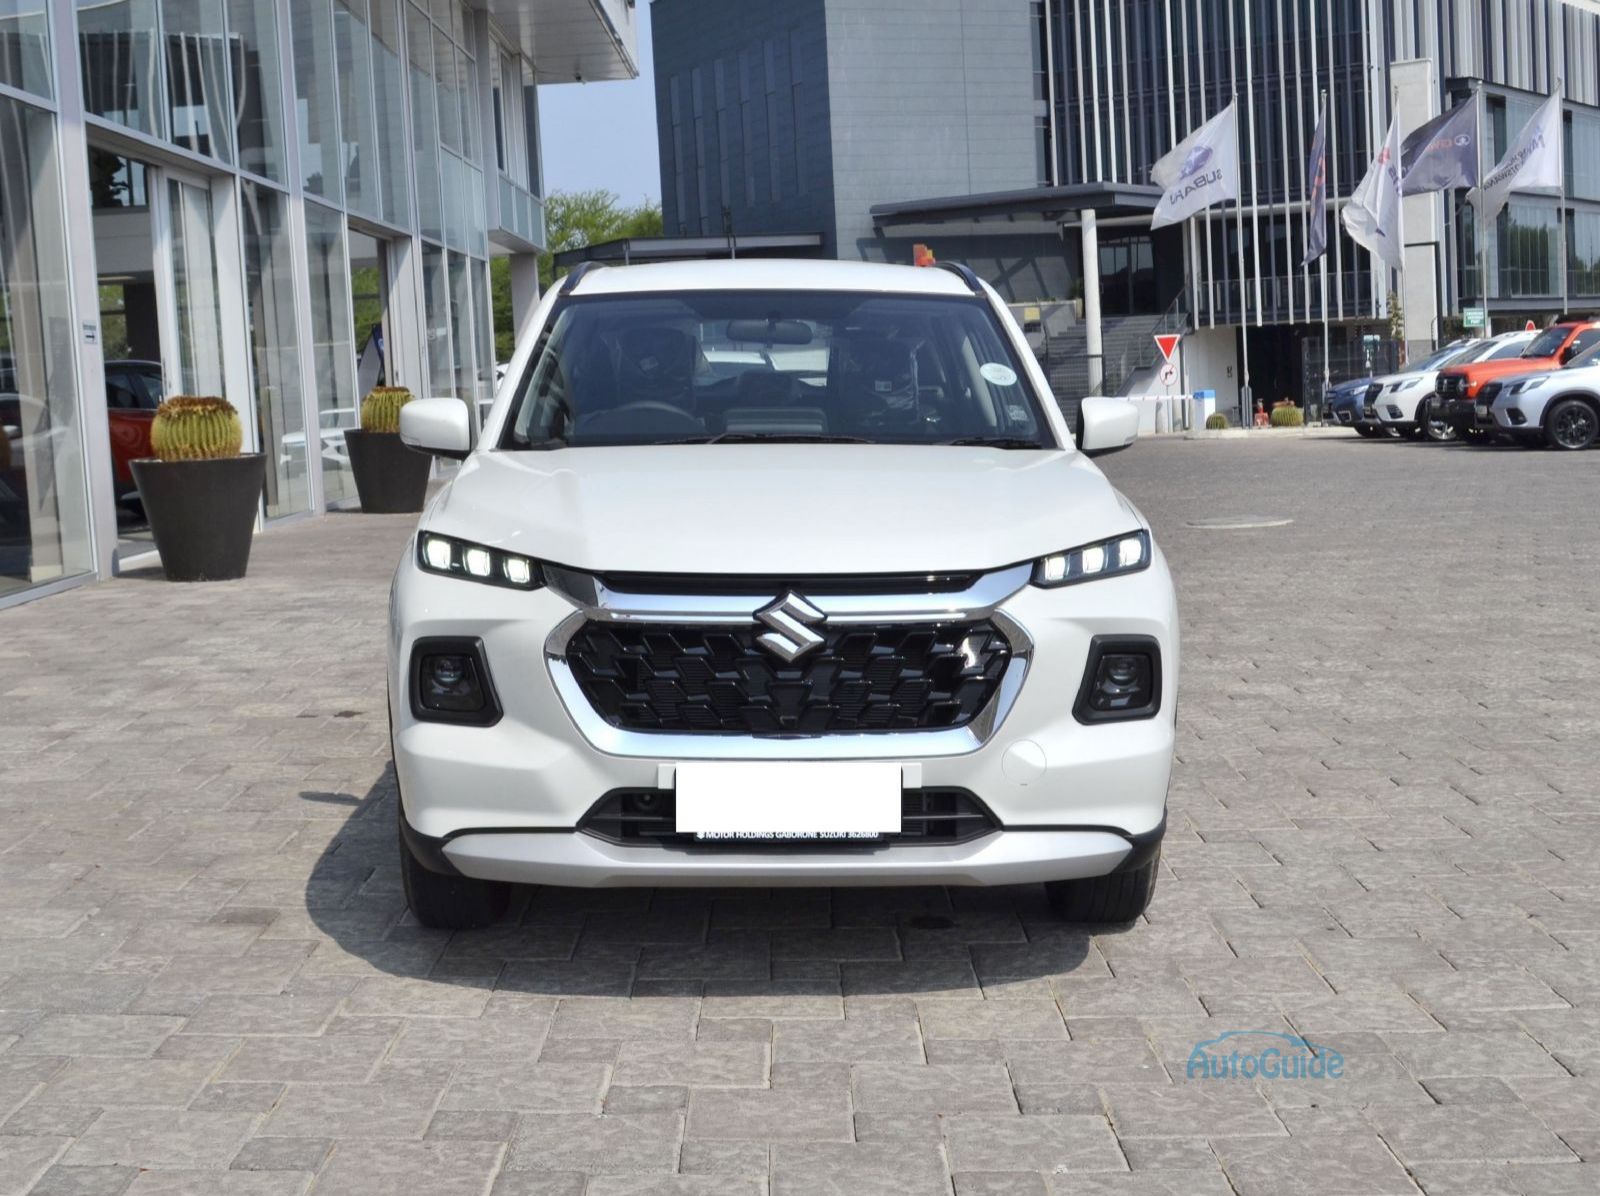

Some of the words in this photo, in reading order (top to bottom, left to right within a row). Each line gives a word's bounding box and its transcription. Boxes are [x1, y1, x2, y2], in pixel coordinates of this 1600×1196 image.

[706, 831, 735, 839] MOTOR
[736, 831, 774, 839] HOLDINGS
[775, 831, 818, 839] GABORONE
[819, 831, 847, 839] SUZUKI
